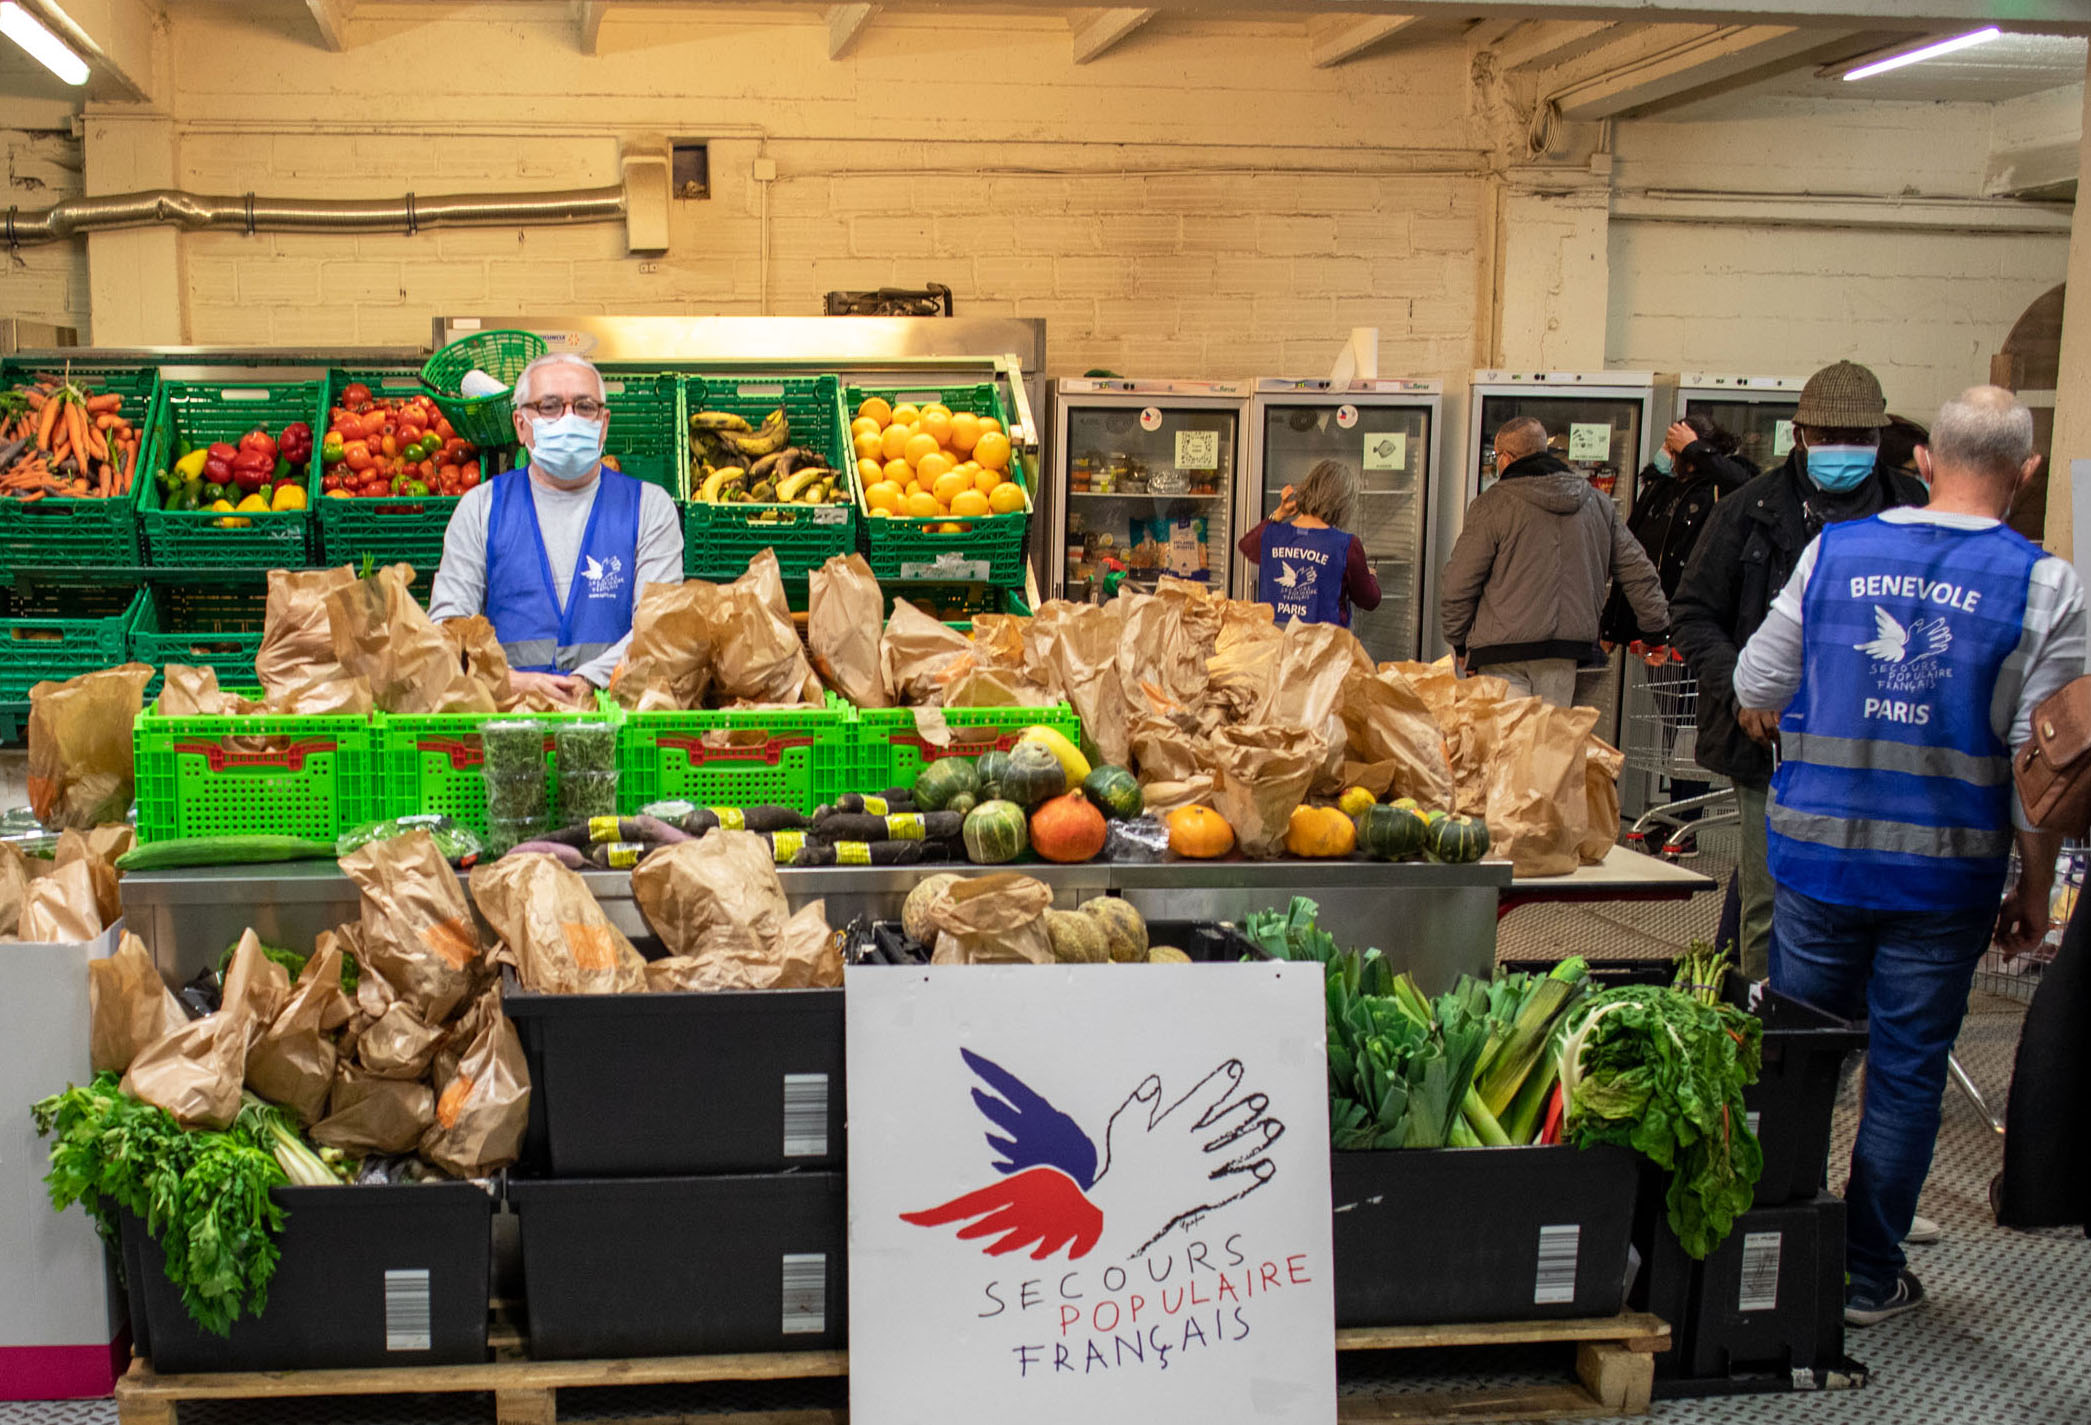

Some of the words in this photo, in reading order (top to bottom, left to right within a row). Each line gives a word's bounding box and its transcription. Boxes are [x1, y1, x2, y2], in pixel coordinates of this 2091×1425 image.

[1272, 547, 1328, 565] BENEVOLE
[1850, 575, 1981, 613] BENEVOLE
[1277, 602, 1307, 616] PARIS
[1869, 660, 1938, 675] SECOURS
[1888, 668, 1953, 682] POPULAIRE
[1863, 697, 1931, 726] PARIS
[978, 1234, 1246, 1318] SECOURS
[1059, 1254, 1312, 1336] POPULAIRE
[1012, 1306, 1251, 1378] FRANÇAIS
